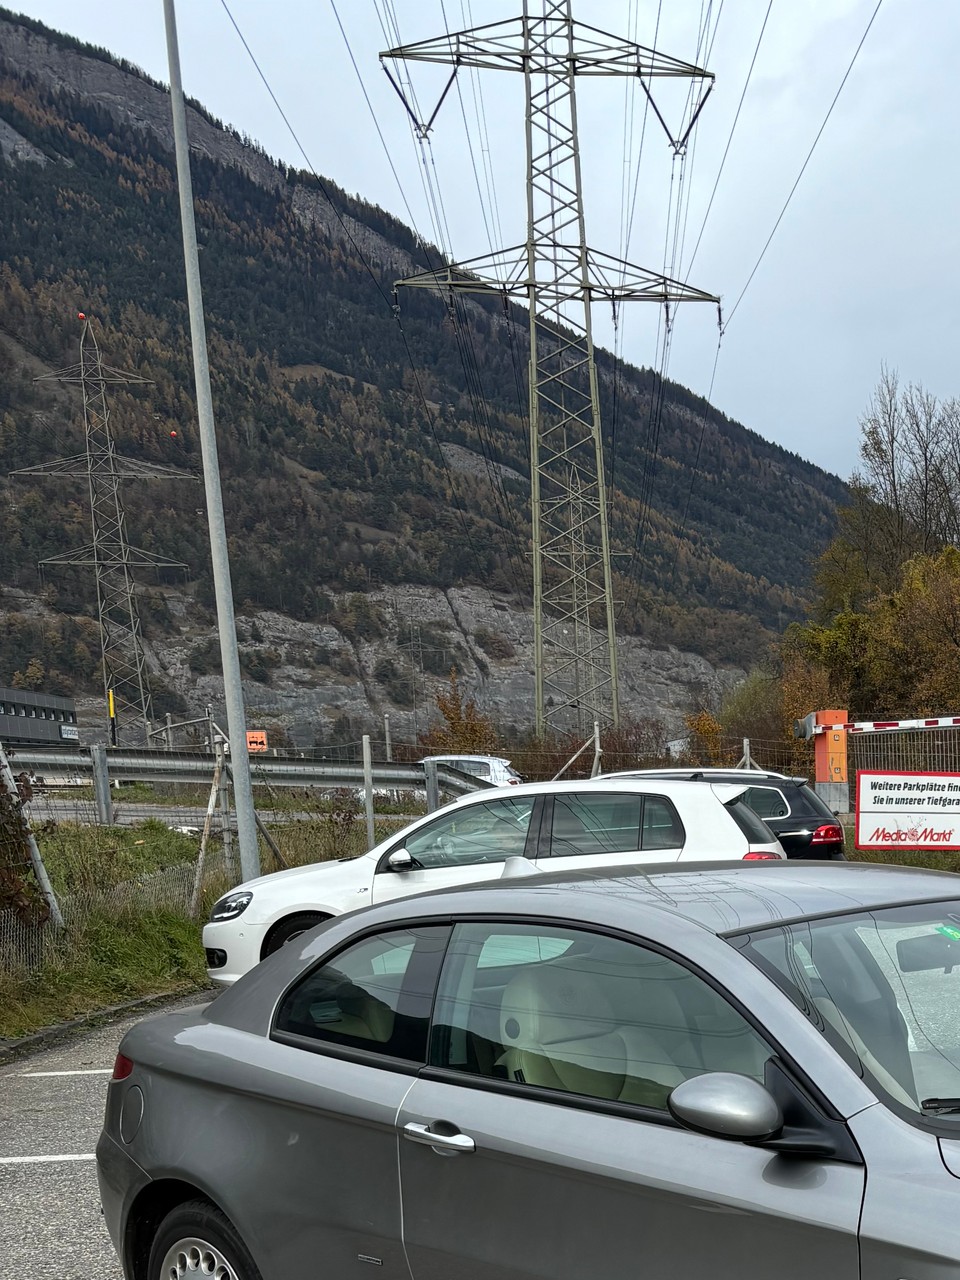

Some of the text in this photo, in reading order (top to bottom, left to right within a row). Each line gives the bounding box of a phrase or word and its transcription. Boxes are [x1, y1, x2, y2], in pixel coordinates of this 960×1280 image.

[870, 781, 902, 791] Weitere
[902, 781, 946, 793] Parkplätze
[872, 795, 885, 805] Sie
[885, 795, 894, 805] in
[894, 797, 926, 806] unserer
